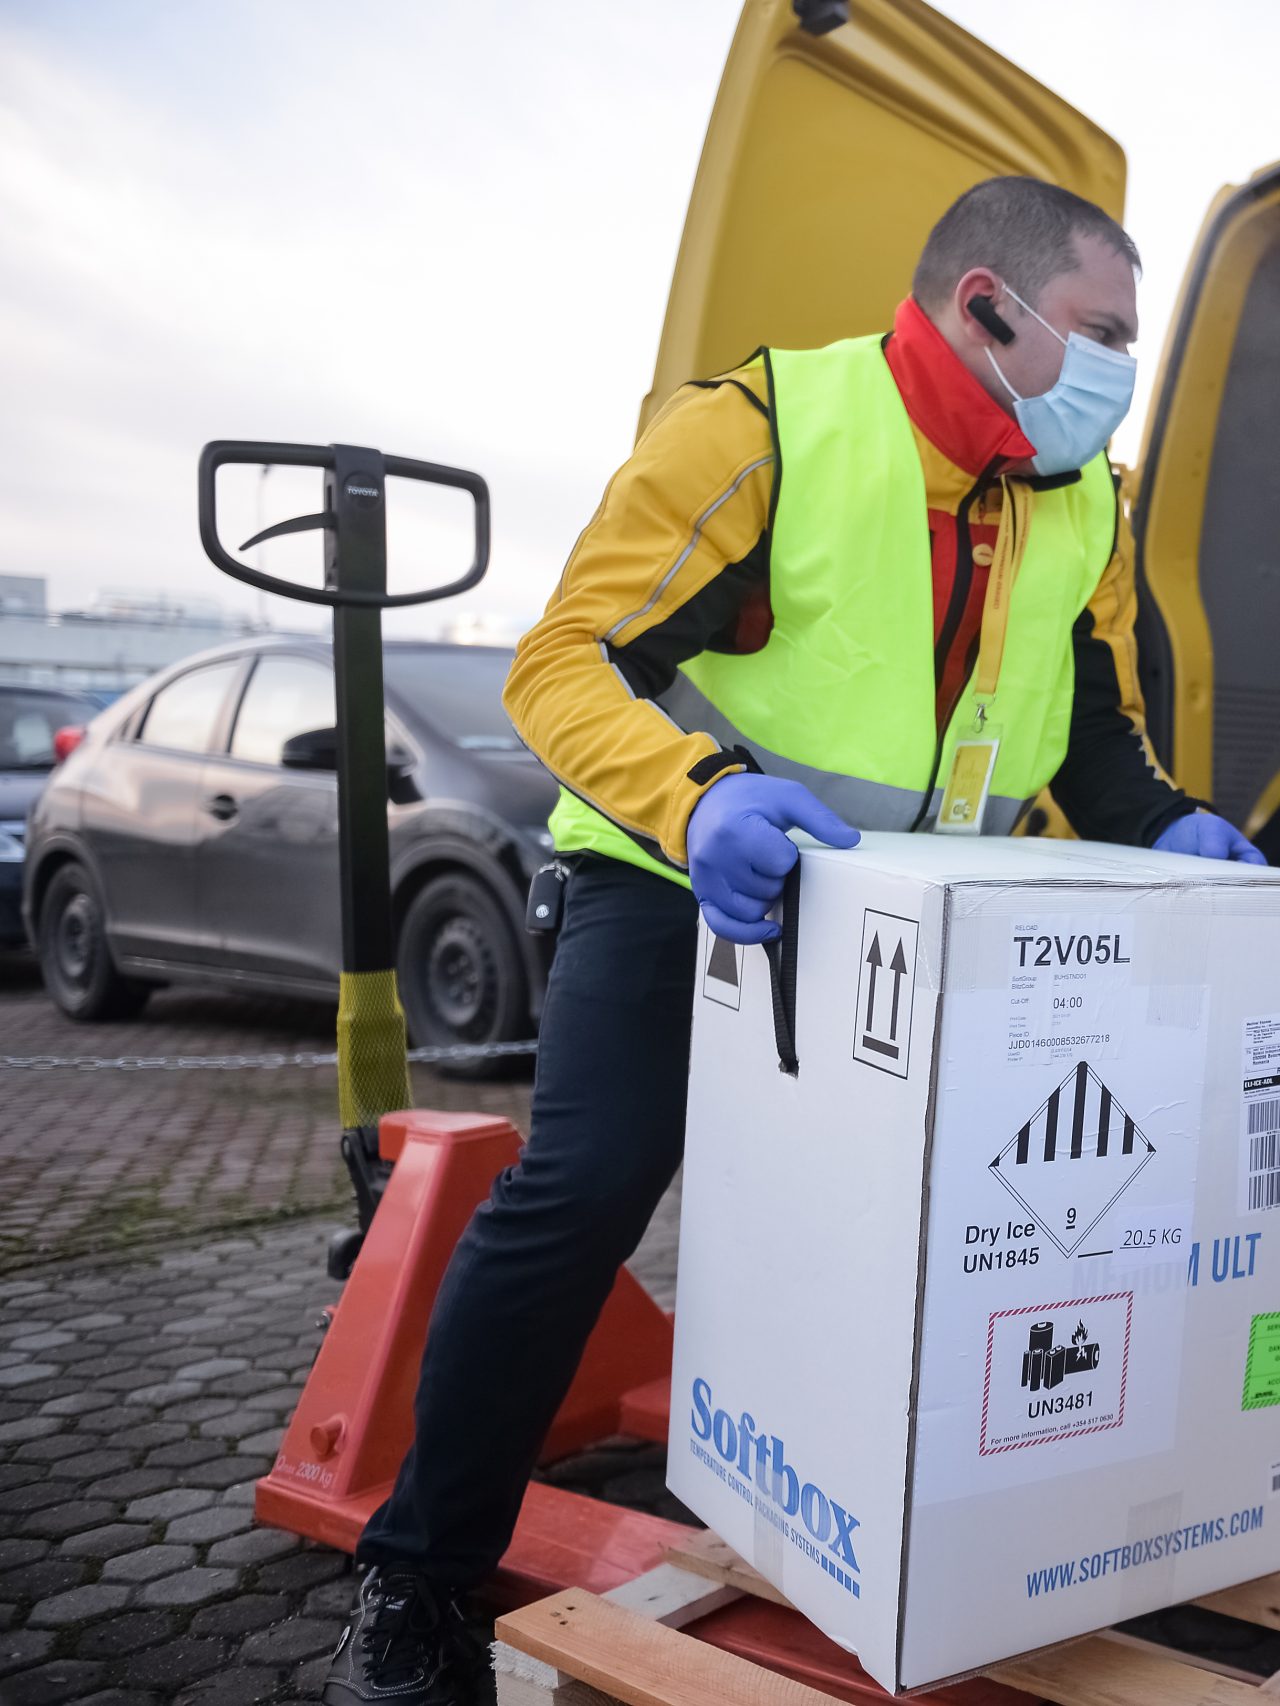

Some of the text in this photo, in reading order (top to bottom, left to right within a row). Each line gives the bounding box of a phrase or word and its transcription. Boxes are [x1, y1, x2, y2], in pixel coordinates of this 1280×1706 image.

[347, 486, 378, 497] TOYOTA
[1013, 934, 1131, 967] T2V05L
[1053, 996, 1083, 1009] 04:00
[1066, 1207, 1077, 1225] 9
[964, 1221, 1036, 1247] Dry Ice
[1123, 1228, 1182, 1246] 20.5 KG
[963, 1247, 1040, 1274] UN1845
[1211, 1232, 1262, 1284] ULT
[1027, 1390, 1094, 1419] UN3481
[990, 1438, 1003, 1446] For
[1003, 1434, 1020, 1443] more
[1021, 1427, 1059, 1440] information,
[1059, 1423, 1071, 1432] call
[319, 1467, 334, 1489] kg
[690, 1377, 861, 1574] Softbox
[689, 1438, 820, 1564] TEMPERATURE CONTROL PACKAGING SYSTEMS
[1027, 1505, 1264, 1599] WWW.SOFTBOXSYSTEMS.COM
